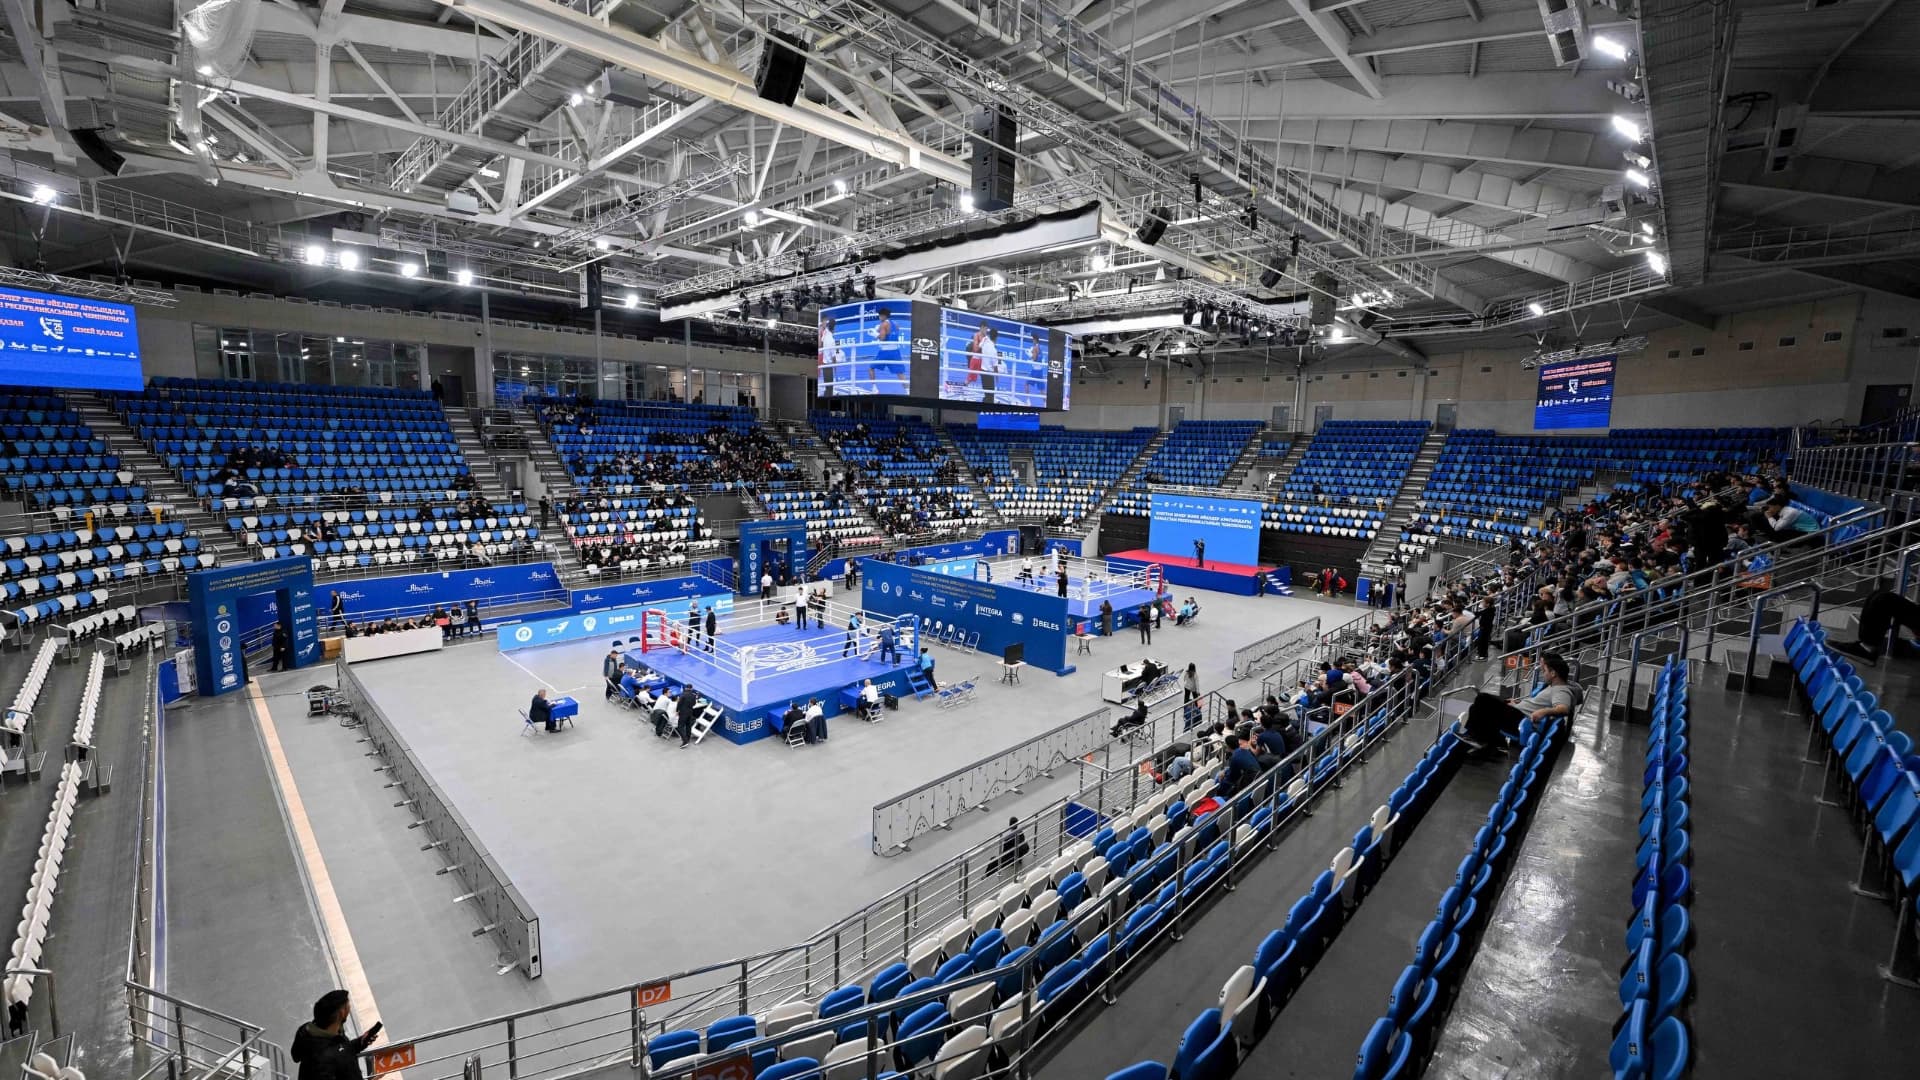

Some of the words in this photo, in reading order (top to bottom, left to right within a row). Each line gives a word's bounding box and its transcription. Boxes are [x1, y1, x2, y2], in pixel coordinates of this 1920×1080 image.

[977, 604, 1003, 617] INTEGRA
[1038, 620, 1060, 631] BELES
[731, 717, 763, 733] BELES
[642, 986, 667, 1003] D7
[389, 1049, 412, 1066] A1
